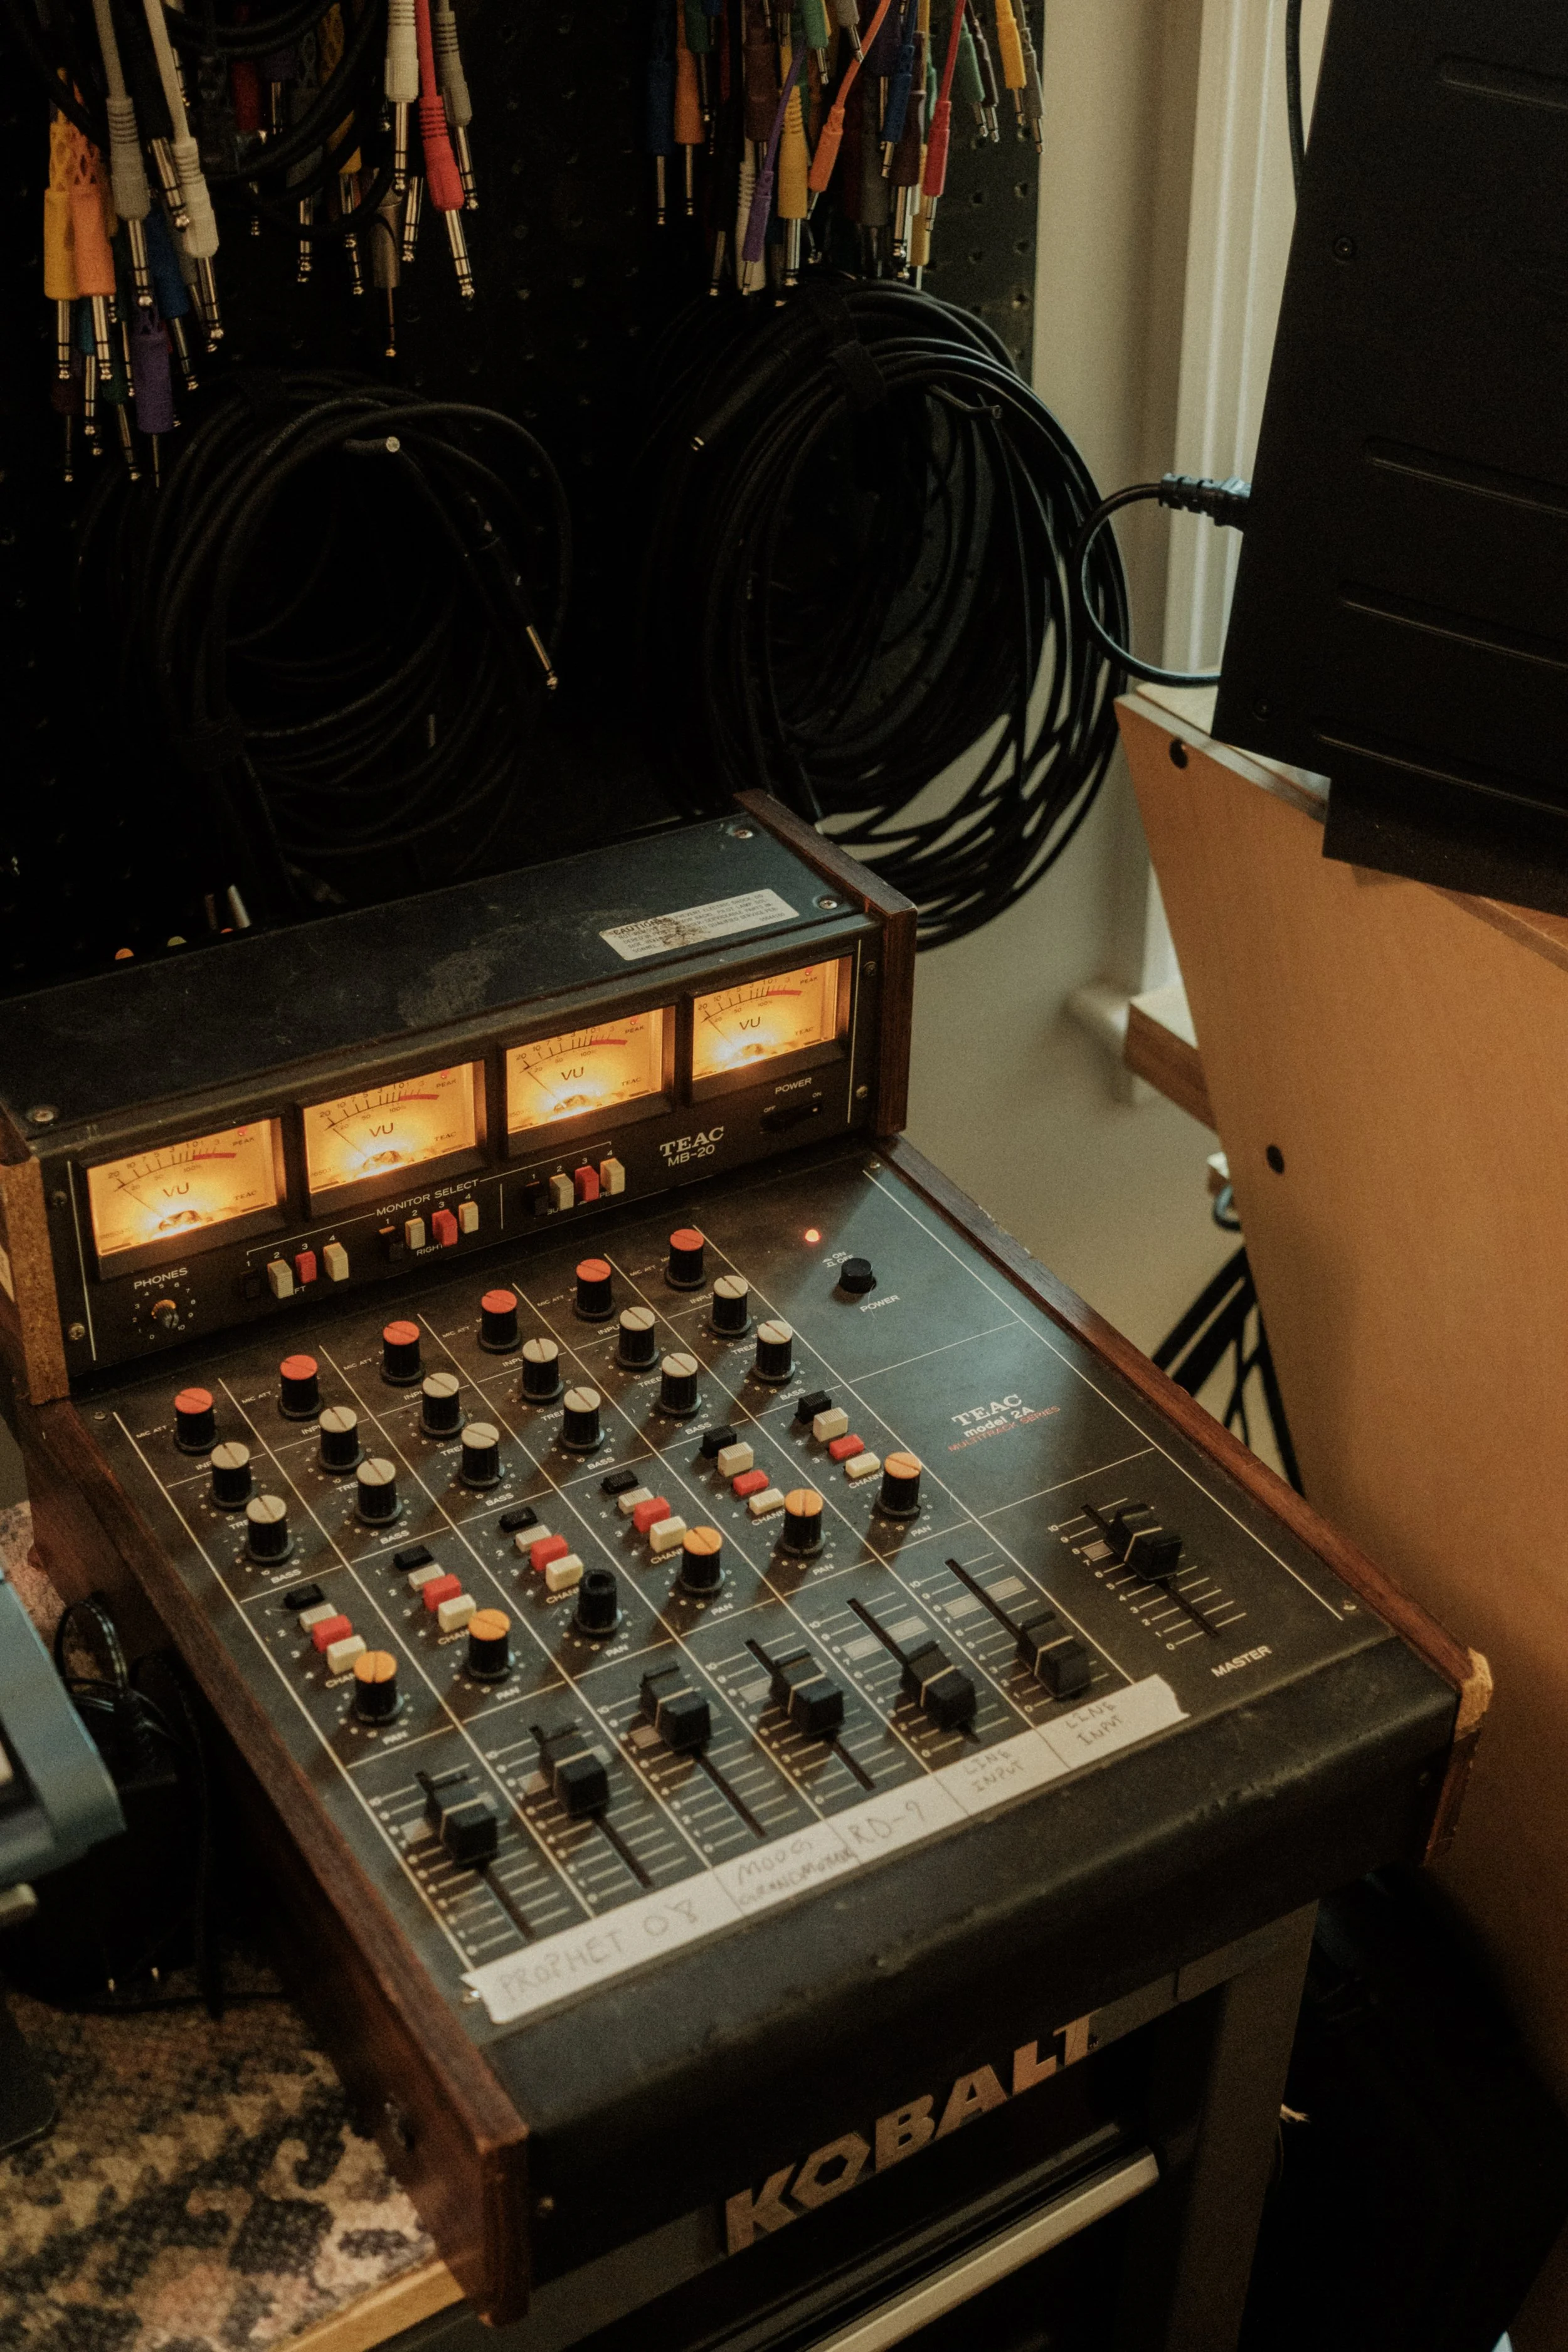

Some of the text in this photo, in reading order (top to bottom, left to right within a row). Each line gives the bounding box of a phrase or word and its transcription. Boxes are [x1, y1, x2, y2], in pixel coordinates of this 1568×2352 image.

[625, 1025, 644, 1034] PEAK
[739, 1017, 761, 1030] VU
[795, 1027, 813, 1035] TEAC
[561, 1067, 584, 1081] VU
[436, 1080, 457, 1089] PEAK
[622, 1078, 642, 1086] TEAC
[775, 1078, 812, 1094] POWER
[369, 1123, 394, 1137] VU
[434, 1132, 457, 1142] TEAC
[233, 1138, 255, 1147] PEAK
[660, 1126, 724, 1157] TEAC
[667, 1145, 715, 1167] MB-20
[162, 1182, 189, 1197] VU
[234, 1190, 257, 1200] TEAC
[376, 1179, 479, 1216] MONITOR SELECT
[832, 1251, 847, 1259] ON
[134, 1268, 188, 1289] PHONES
[294, 1286, 305, 1294] FT
[859, 1295, 901, 1313] POWER
[597, 1324, 620, 1335] INPU
[731, 1343, 757, 1355] TREB
[502, 1357, 523, 1367] INPU
[258, 1391, 272, 1399] ATT
[780, 1388, 807, 1401] BASS
[541, 1411, 564, 1422] TRE
[951, 1394, 1022, 1426] TEAC
[686, 1422, 712, 1435] BASS
[948, 1406, 1061, 1453] MULTITRACK SERIES
[963, 1407, 1035, 1438] model 2A
[136, 1425, 168, 1439] MIC ATT
[587, 1457, 615, 1470] BASS
[849, 1471, 885, 1489] CHANN
[485, 1493, 514, 1506] BASS
[751, 1509, 785, 1526] CHANN
[911, 1526, 931, 1537] PAN
[1047, 1524, 1059, 1532] 10
[380, 1530, 410, 1544] BASS
[650, 1548, 684, 1564] CHAN
[271, 1569, 302, 1584] BASS
[812, 1564, 834, 1576] PAN
[546, 1587, 580, 1604] CHAN
[711, 1604, 734, 1616] PAN
[438, 1631, 469, 1645] CHAN
[605, 1645, 628, 1657] PAN
[1166, 1643, 1175, 1651] 0
[1210, 1645, 1273, 1678] MASTER
[495, 1687, 521, 1700] PAN
[1064, 1701, 1116, 1729] LINE
[1077, 1715, 1125, 1745] INPUT
[382, 1730, 408, 1745] PAN
[961, 1749, 1010, 1775] LINE
[972, 1759, 1024, 1793] INPUT
[849, 1800, 925, 1844] RD-9
[738, 1839, 812, 1884] MOOG
[502, 1930, 623, 2001] PROPHET
[725, 2016, 1089, 2256] KOBALT
